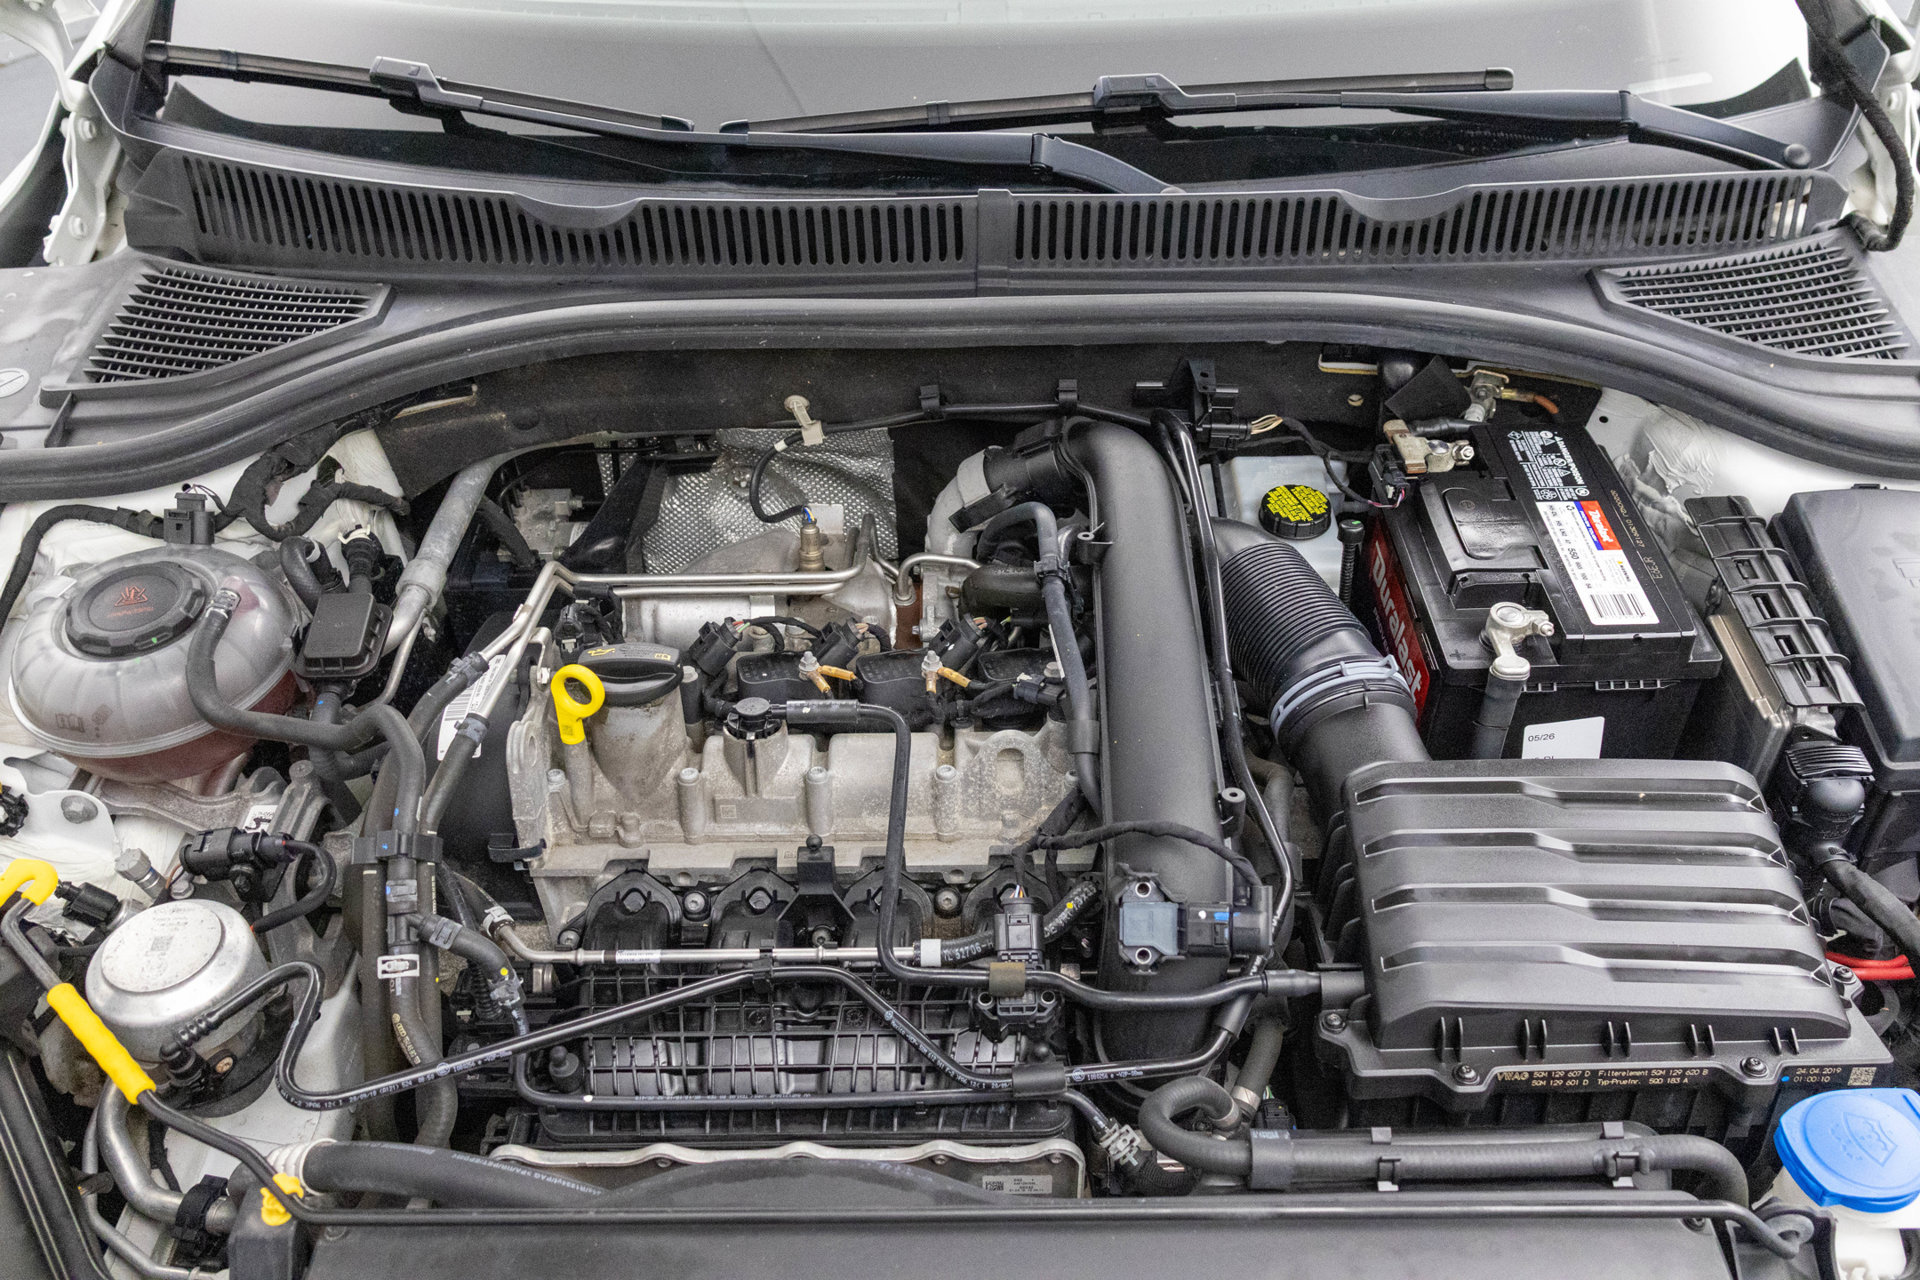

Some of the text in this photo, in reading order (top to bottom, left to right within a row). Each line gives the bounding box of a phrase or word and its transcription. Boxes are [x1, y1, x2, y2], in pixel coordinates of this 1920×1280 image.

[1589, 509, 1614, 543] Duralast
[1372, 541, 1422, 703] Duralast
[1528, 733, 1555, 742] 05/26
